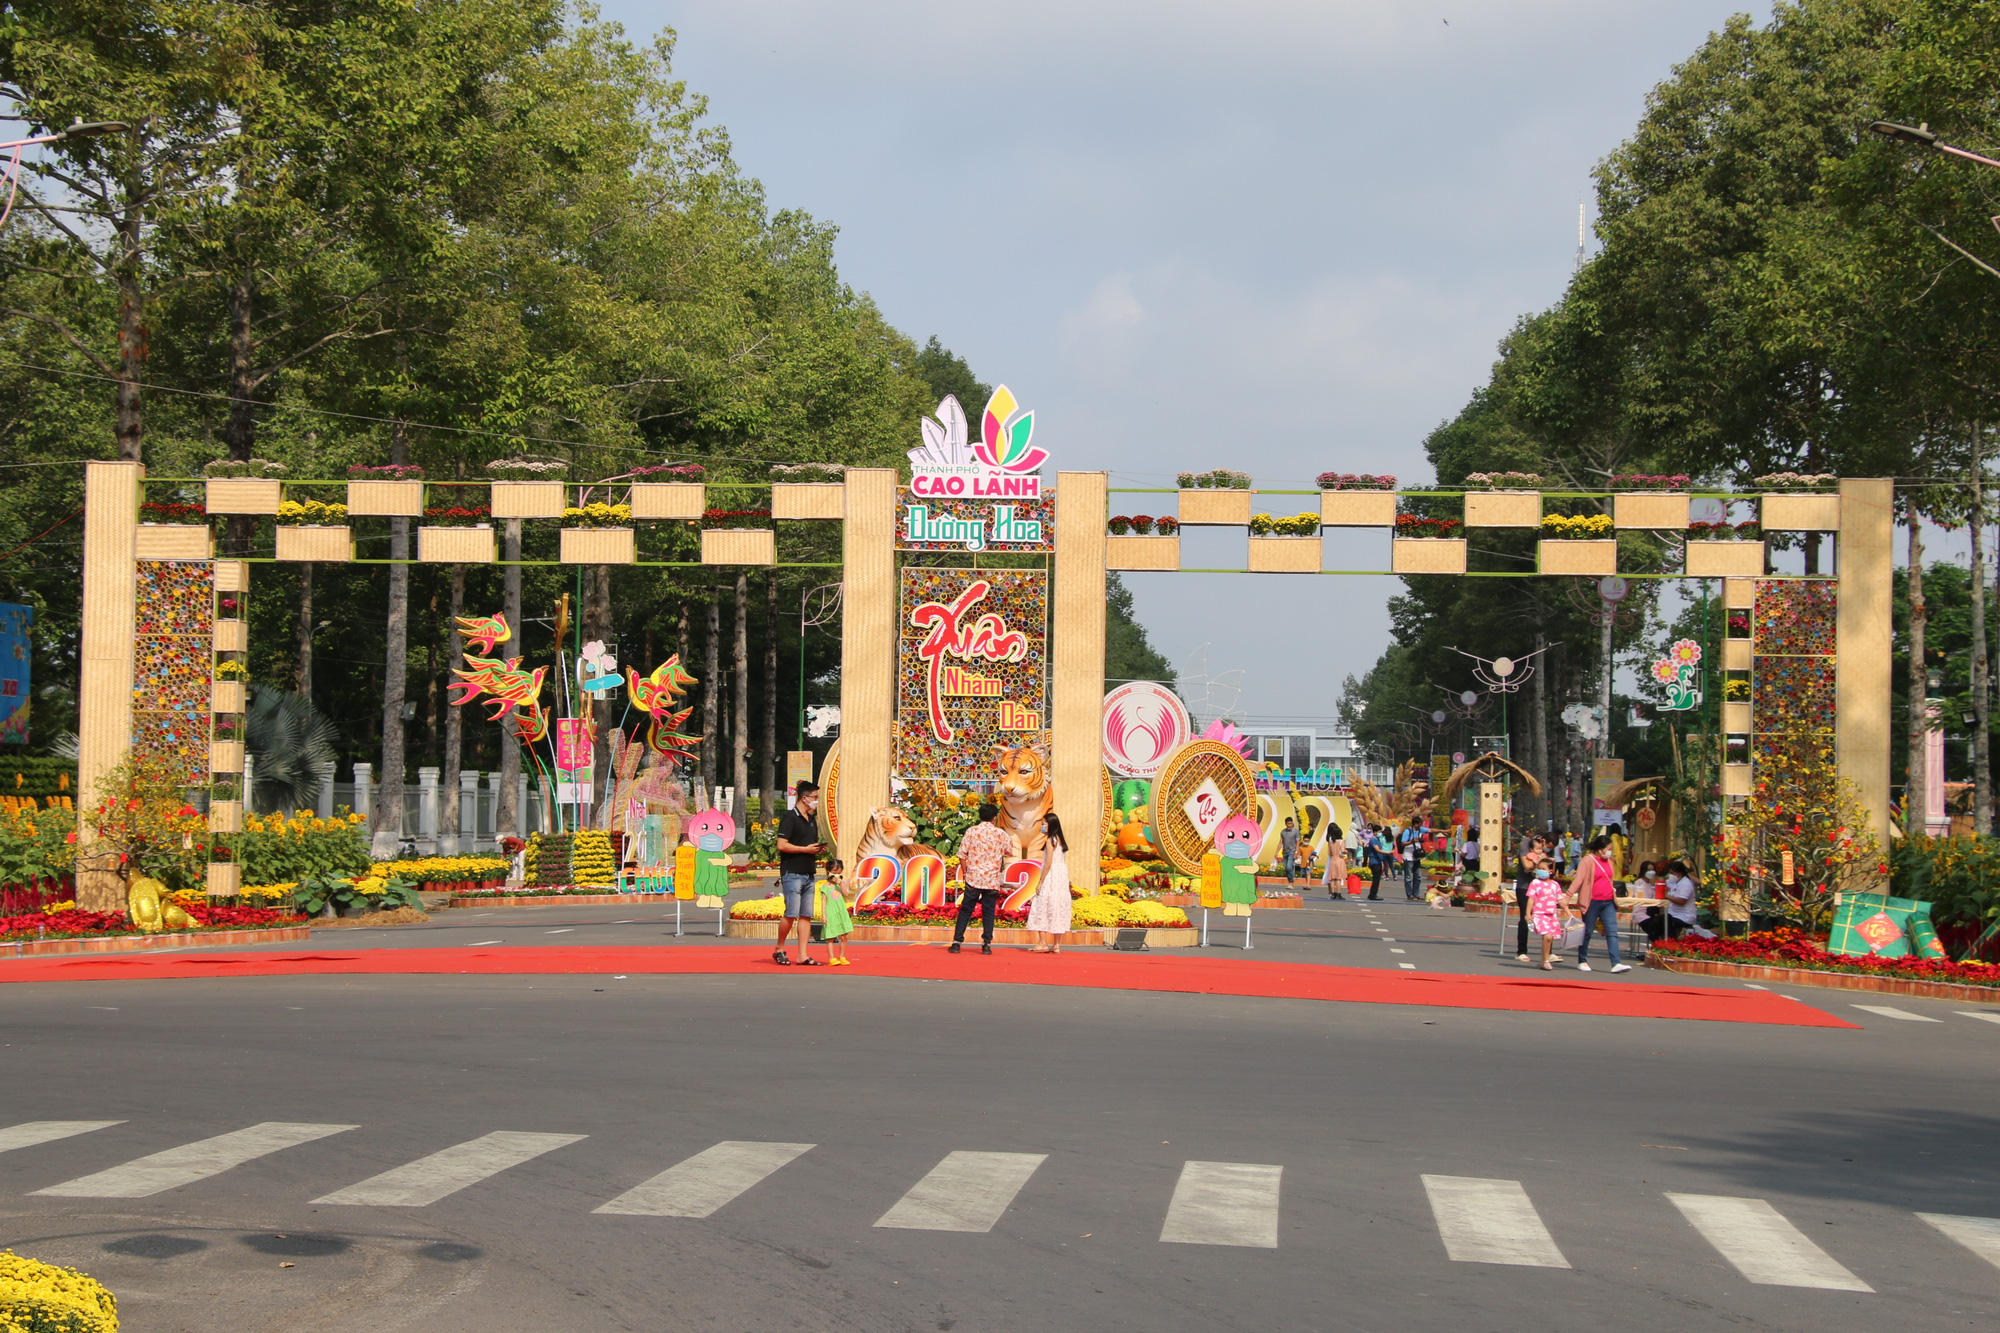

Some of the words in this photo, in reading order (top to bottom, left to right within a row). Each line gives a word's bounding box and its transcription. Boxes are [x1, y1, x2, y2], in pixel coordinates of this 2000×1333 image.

[914, 462, 953, 474] THÀNH
[956, 462, 980, 475] PHỐ
[913, 475, 965, 495] CAO
[973, 470, 1038, 496] LÃNH
[905, 506, 986, 550] Đường
[993, 505, 1042, 541] Hoa
[913, 582, 1026, 742] Xuân
[946, 668, 1001, 695] Nhâm
[1254, 762, 1291, 790] ĂM
[1295, 762, 1343, 791] MỚI
[1202, 868, 1220, 877] Xuân
[1203, 858, 1216, 867] Vui
[680, 883, 690, 891] 5K
[854, 854, 1042, 916] 202
[1204, 880, 1217, 889] An
